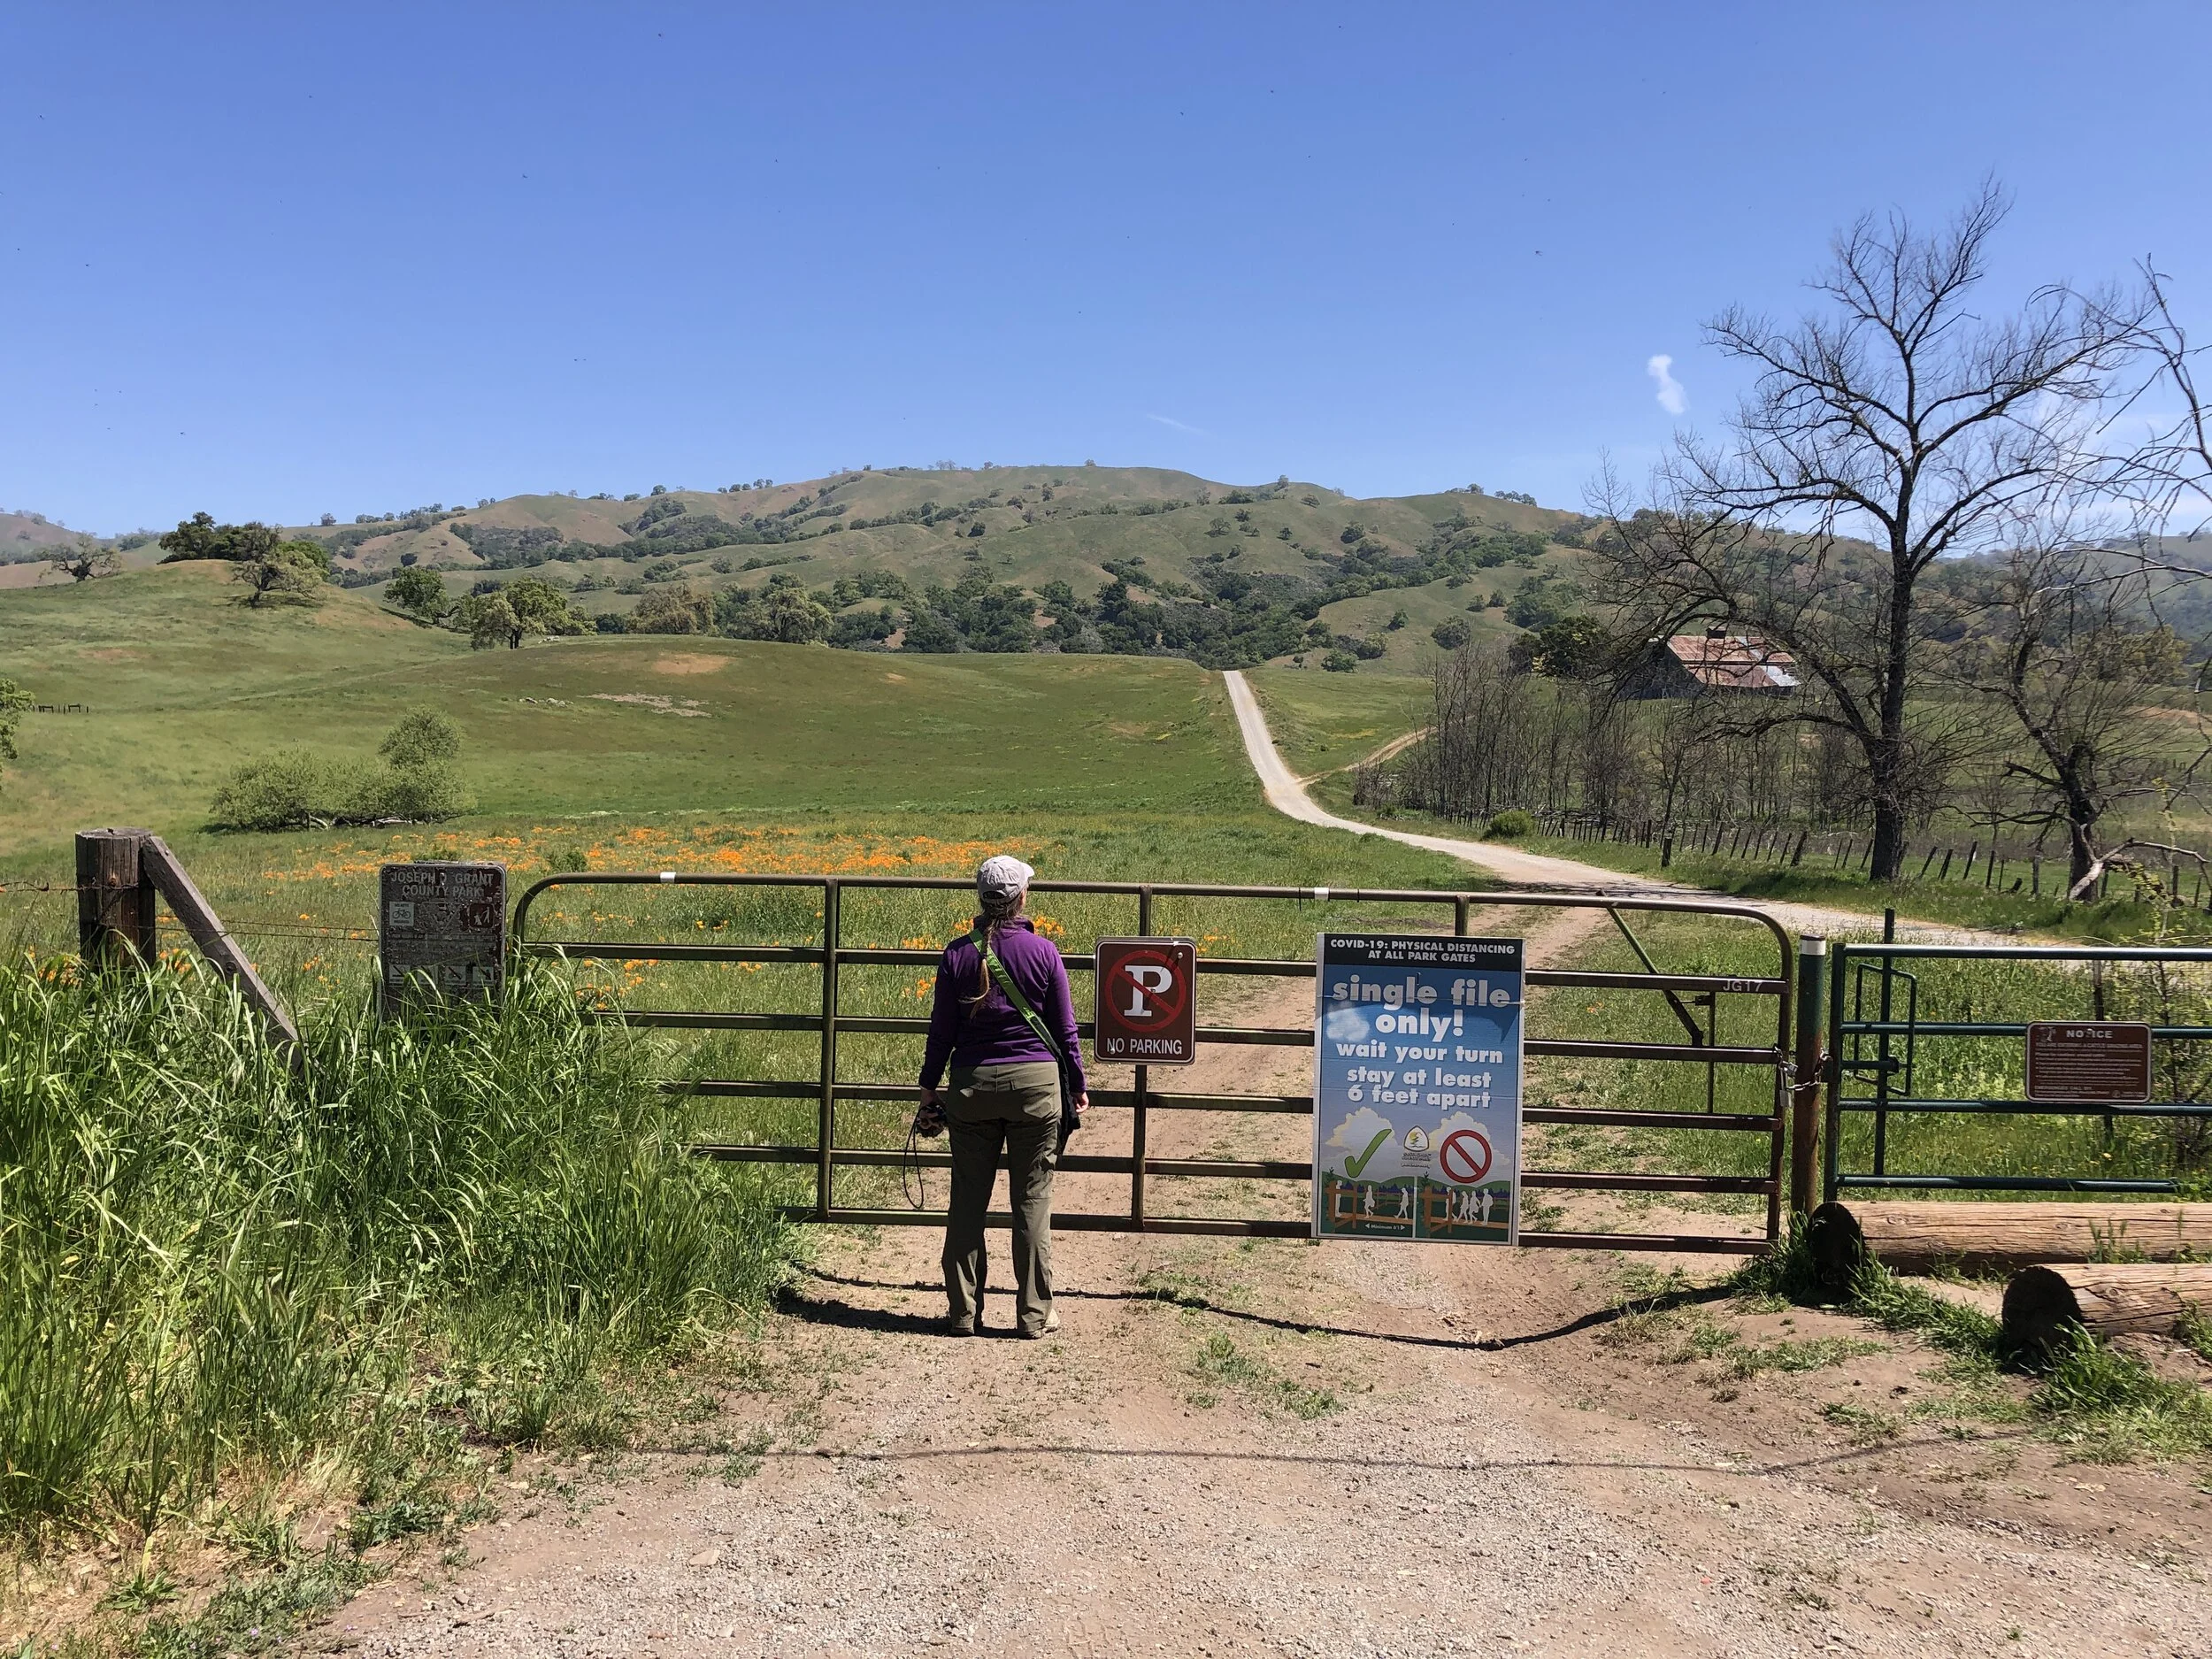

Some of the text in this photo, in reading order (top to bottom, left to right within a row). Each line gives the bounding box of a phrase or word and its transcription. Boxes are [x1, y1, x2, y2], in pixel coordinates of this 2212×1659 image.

[390, 872, 436, 883] JOSEPH
[455, 873, 495, 885] GRANT
[402, 885, 449, 897] COUNTY
[1330, 939, 1516, 955] COVID-19: PHYSICAL DISTANCING
[1368, 950, 1476, 963] AT ALL PARK GATES
[1124, 964, 1173, 1018] P
[1332, 974, 1511, 1011] single file
[1723, 979, 1763, 992] JG17
[1375, 1007, 1464, 1042] only!
[2066, 1029, 2114, 1039] NOICE
[1107, 1037, 1183, 1055] NO PARKING
[1335, 1039, 1503, 1064] wait your turn
[1347, 1065, 1493, 1088] stay at least
[1348, 1084, 1492, 1111] 6 feet apart
